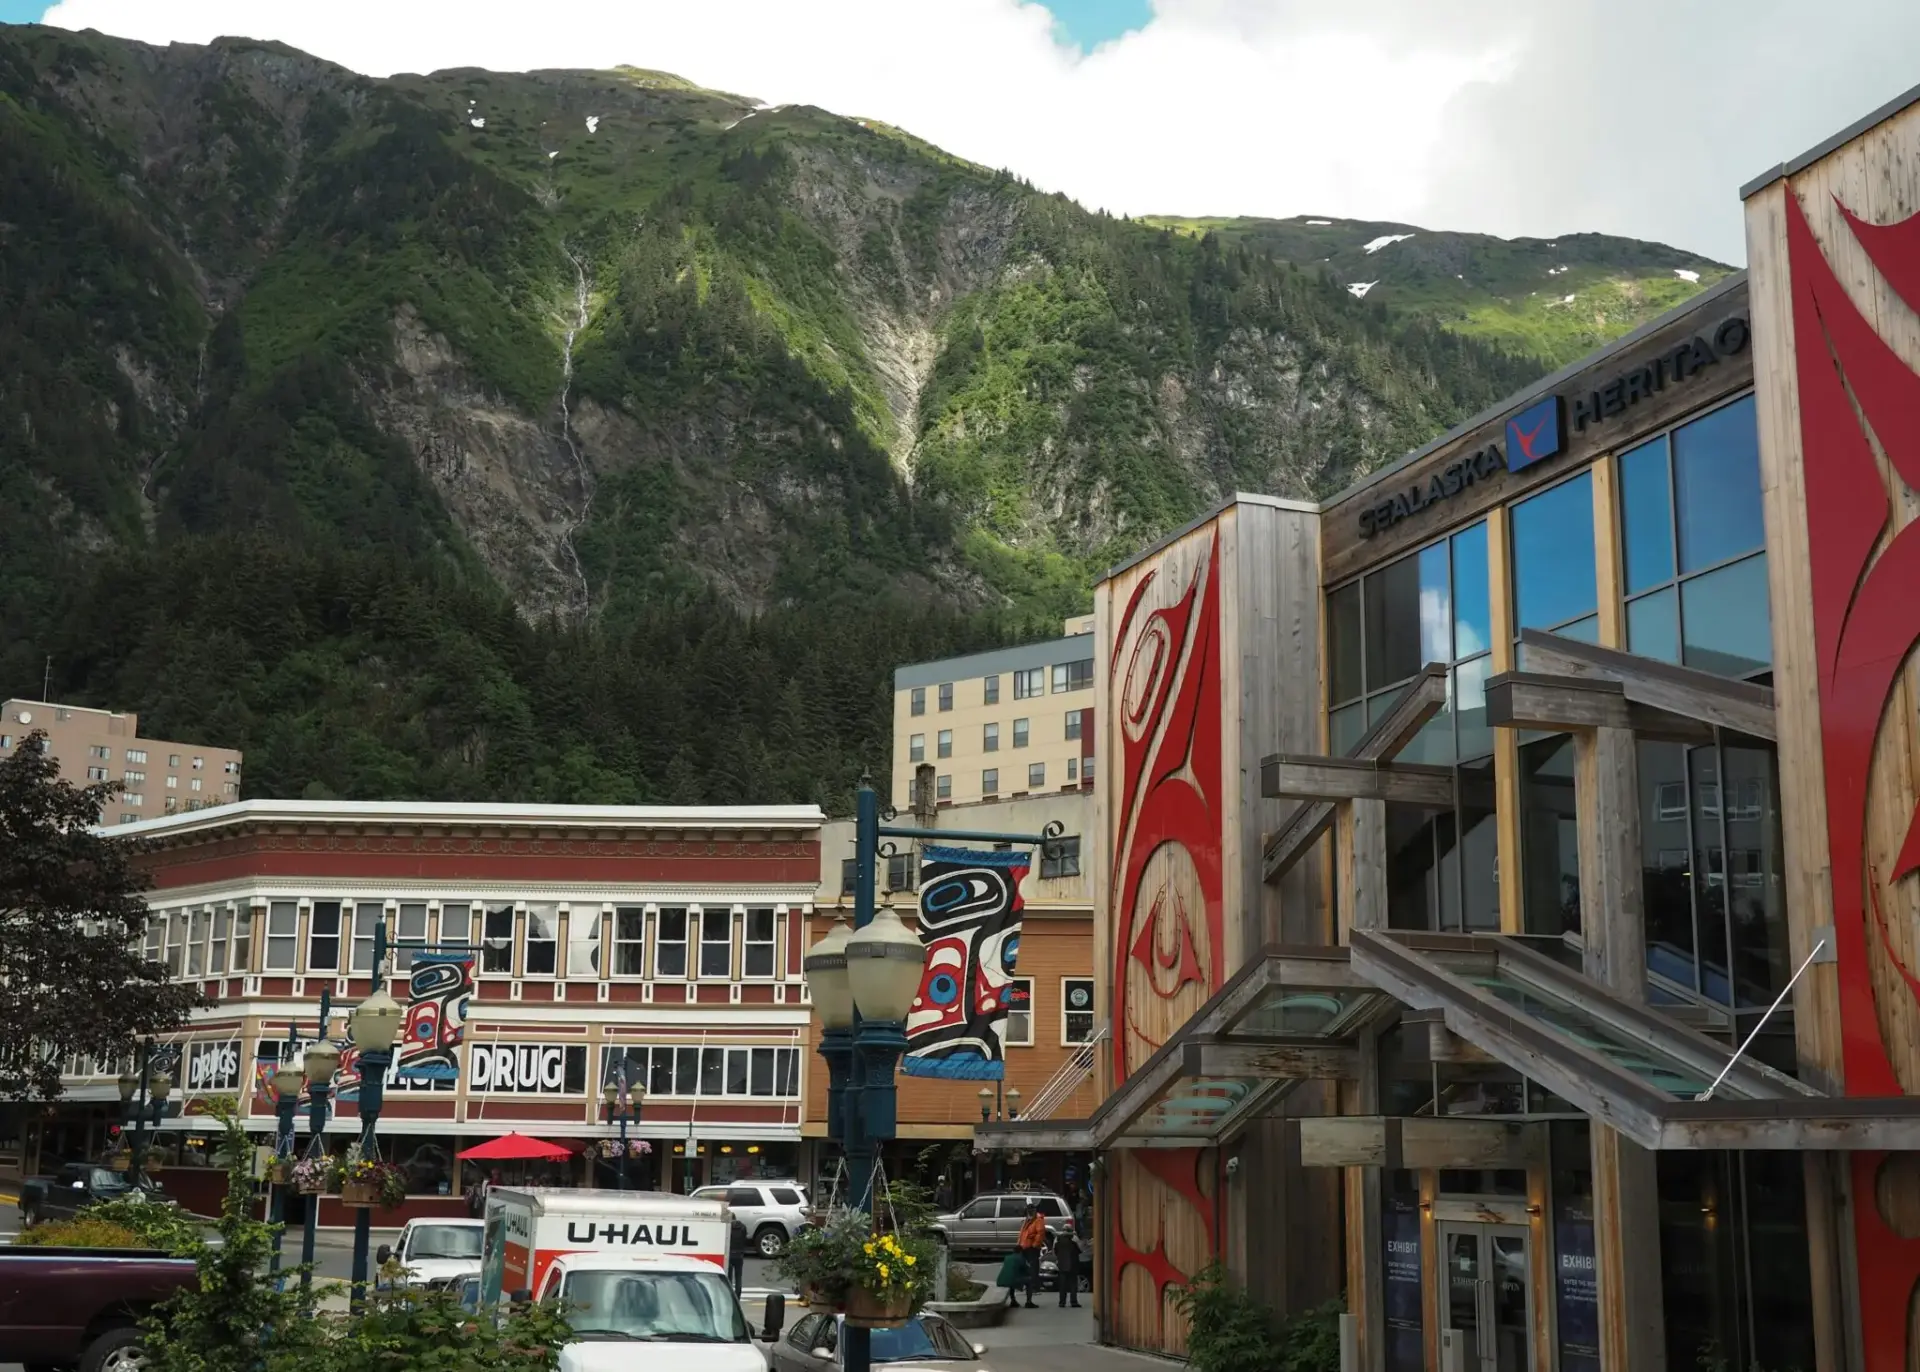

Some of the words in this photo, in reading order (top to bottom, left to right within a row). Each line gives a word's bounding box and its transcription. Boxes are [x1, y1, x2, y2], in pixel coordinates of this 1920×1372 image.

[1359, 444, 1508, 540] SEALASKA
[1572, 317, 1750, 432] HERITAG
[191, 1047, 237, 1083] DRUGS
[471, 1048, 562, 1088] DRUG
[567, 1222, 699, 1246] U-HAUL
[1387, 1240, 1418, 1254] EXHIBIT
[1562, 1255, 1596, 1270] EXHIBI
